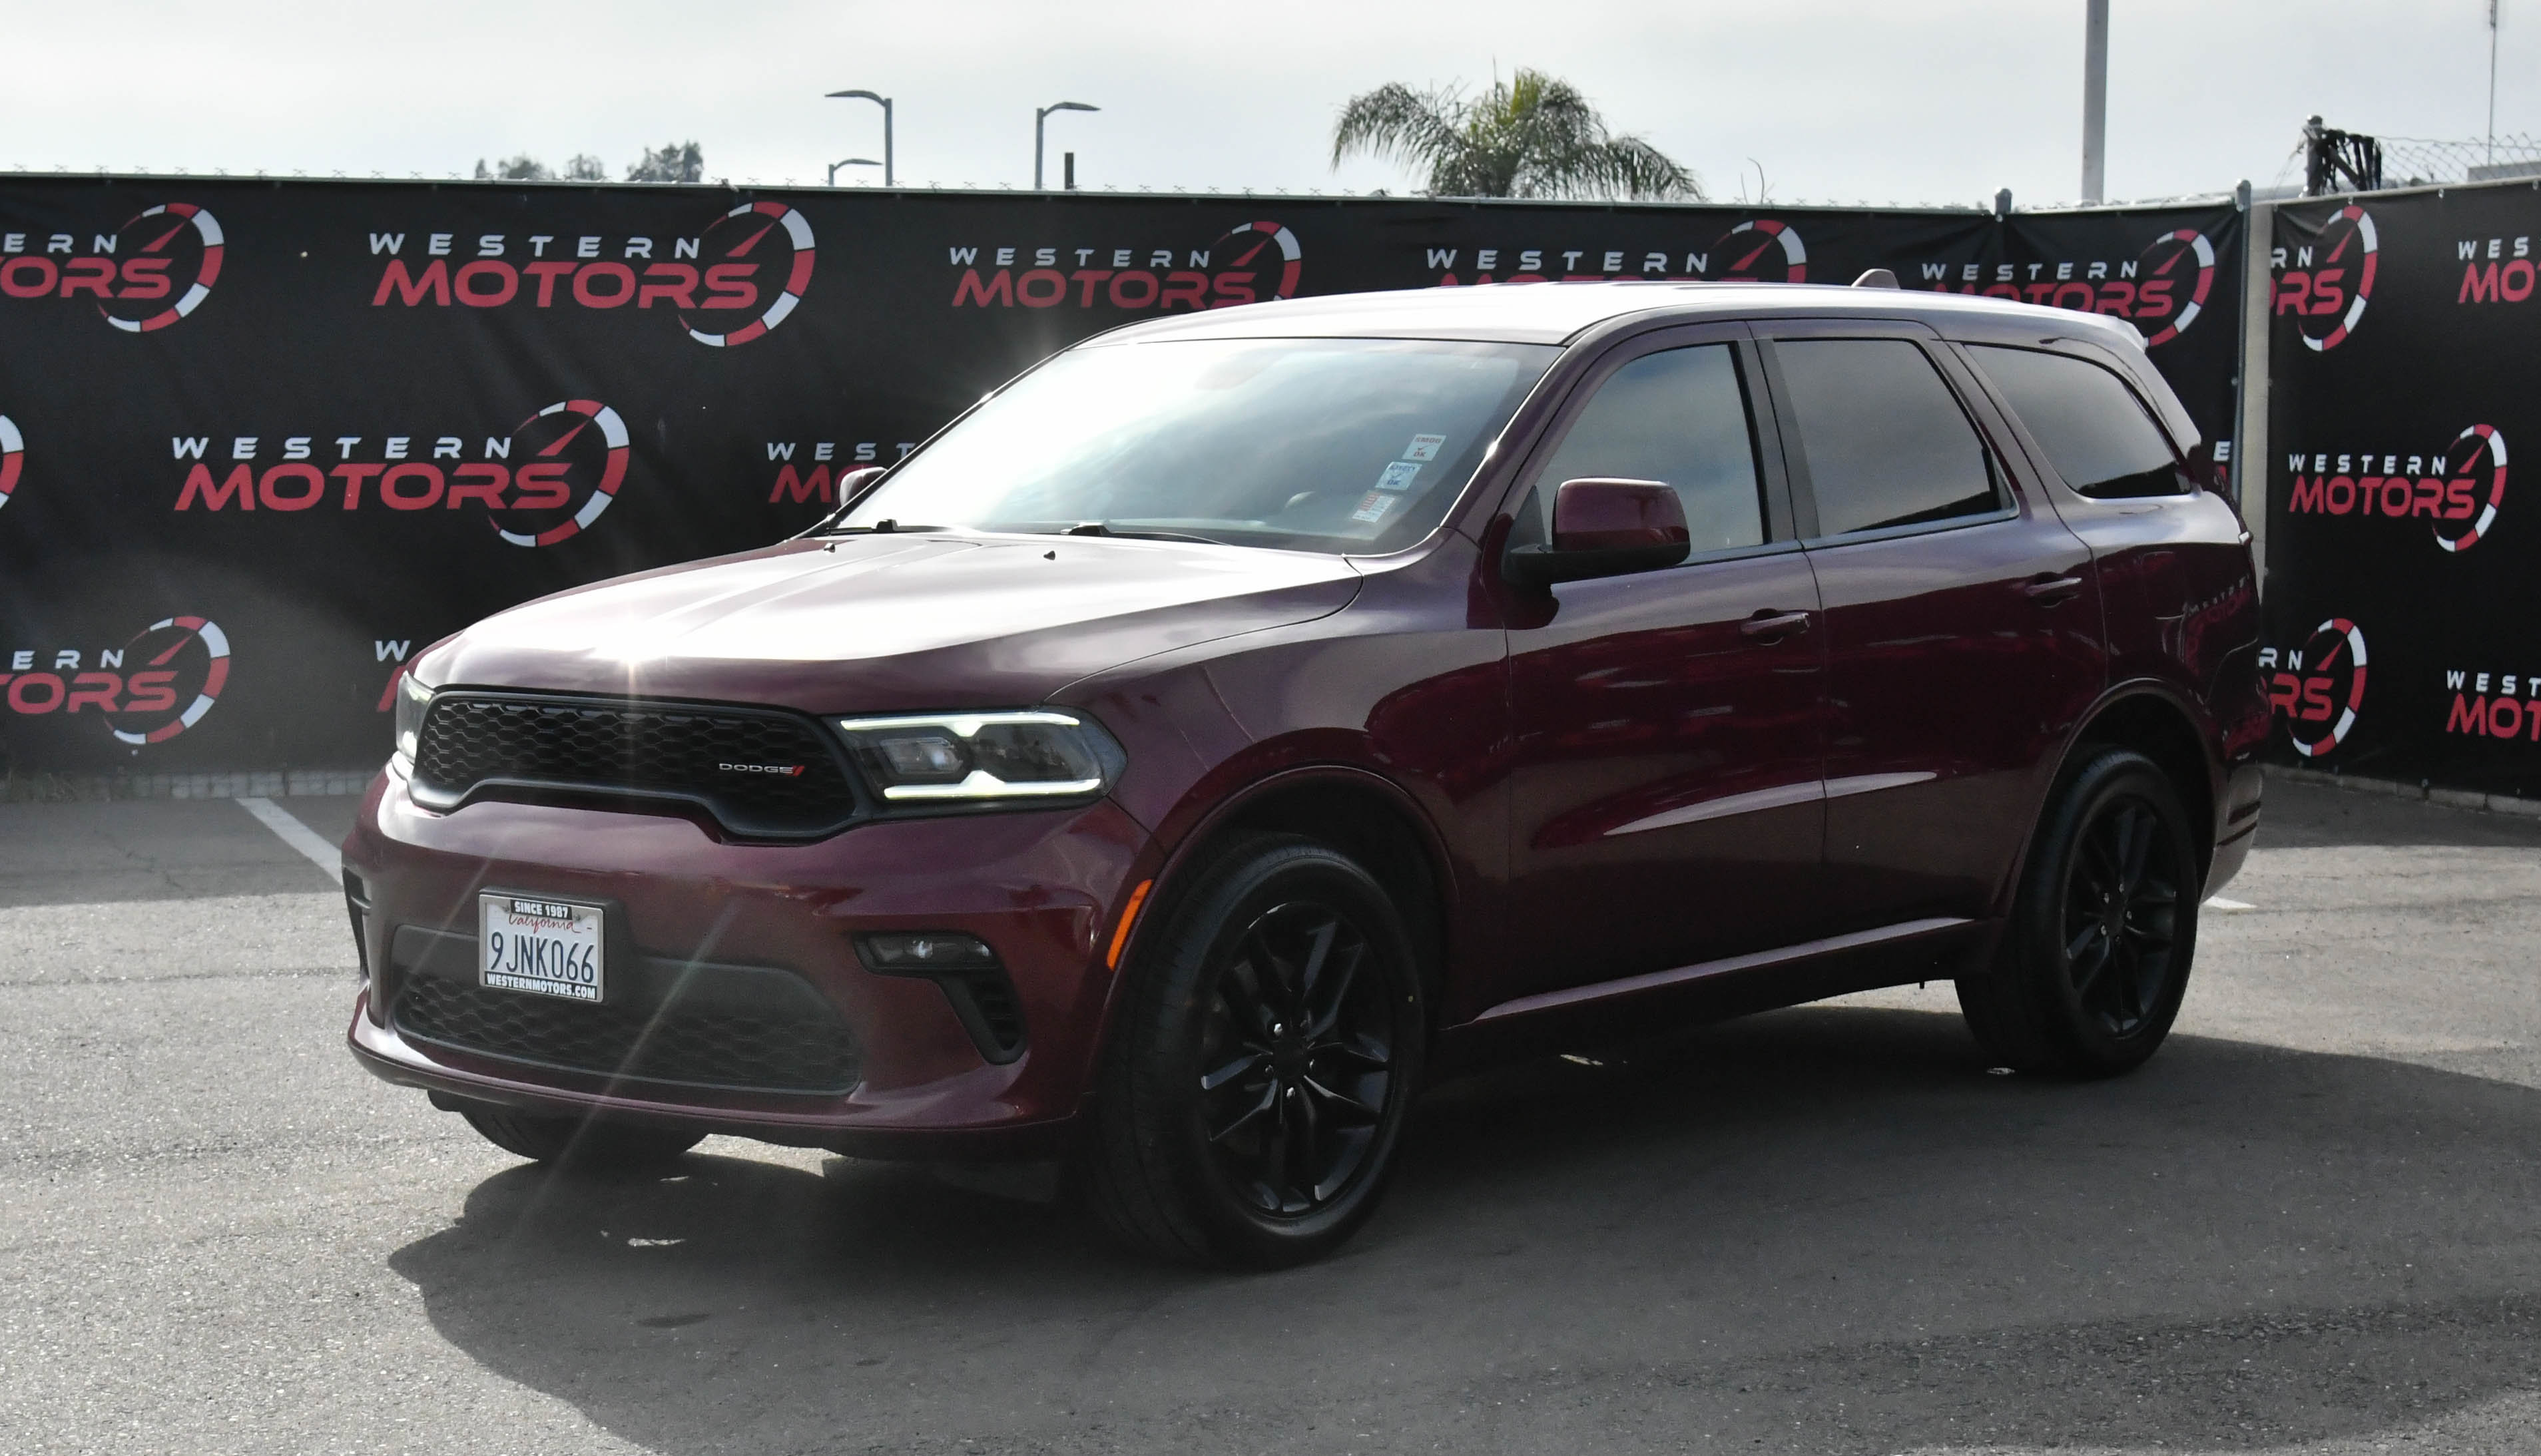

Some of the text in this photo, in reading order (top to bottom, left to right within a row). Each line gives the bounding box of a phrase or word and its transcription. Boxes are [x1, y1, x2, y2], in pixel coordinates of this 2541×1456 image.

[3, 234, 117, 253] ERN
[370, 233, 700, 259] WESTERN
[2458, 236, 2529, 260] WES
[950, 247, 1210, 268] WESTERN
[1427, 249, 1707, 273] WESTERN
[2271, 246, 2313, 268] RN
[0, 256, 172, 299] ORS
[1922, 260, 2137, 281] WESTERN
[2458, 258, 2541, 304] MO
[372, 259, 759, 309] MOTORS
[952, 269, 1256, 310] MOTORS
[2269, 271, 2345, 316] RS
[1934, 280, 2175, 318] TORS
[172, 437, 512, 459] WESTERN
[2289, 454, 2446, 475] WESTERN
[174, 463, 572, 511] MOTORS
[2289, 475, 2476, 519] MOTORS
[12, 649, 124, 670] ERN
[2258, 648, 2303, 670] RN
[0, 671, 178, 714] ORS
[2261, 672, 2334, 721] RS
[2447, 670, 2541, 697] WEST
[719, 763, 794, 774] DODGE
[514, 901, 569, 917] SINCE 1987
[509, 914, 581, 934] California
[491, 931, 594, 983] 9JNK066
[487, 973, 595, 999] WESTERNMOTORS.COM
